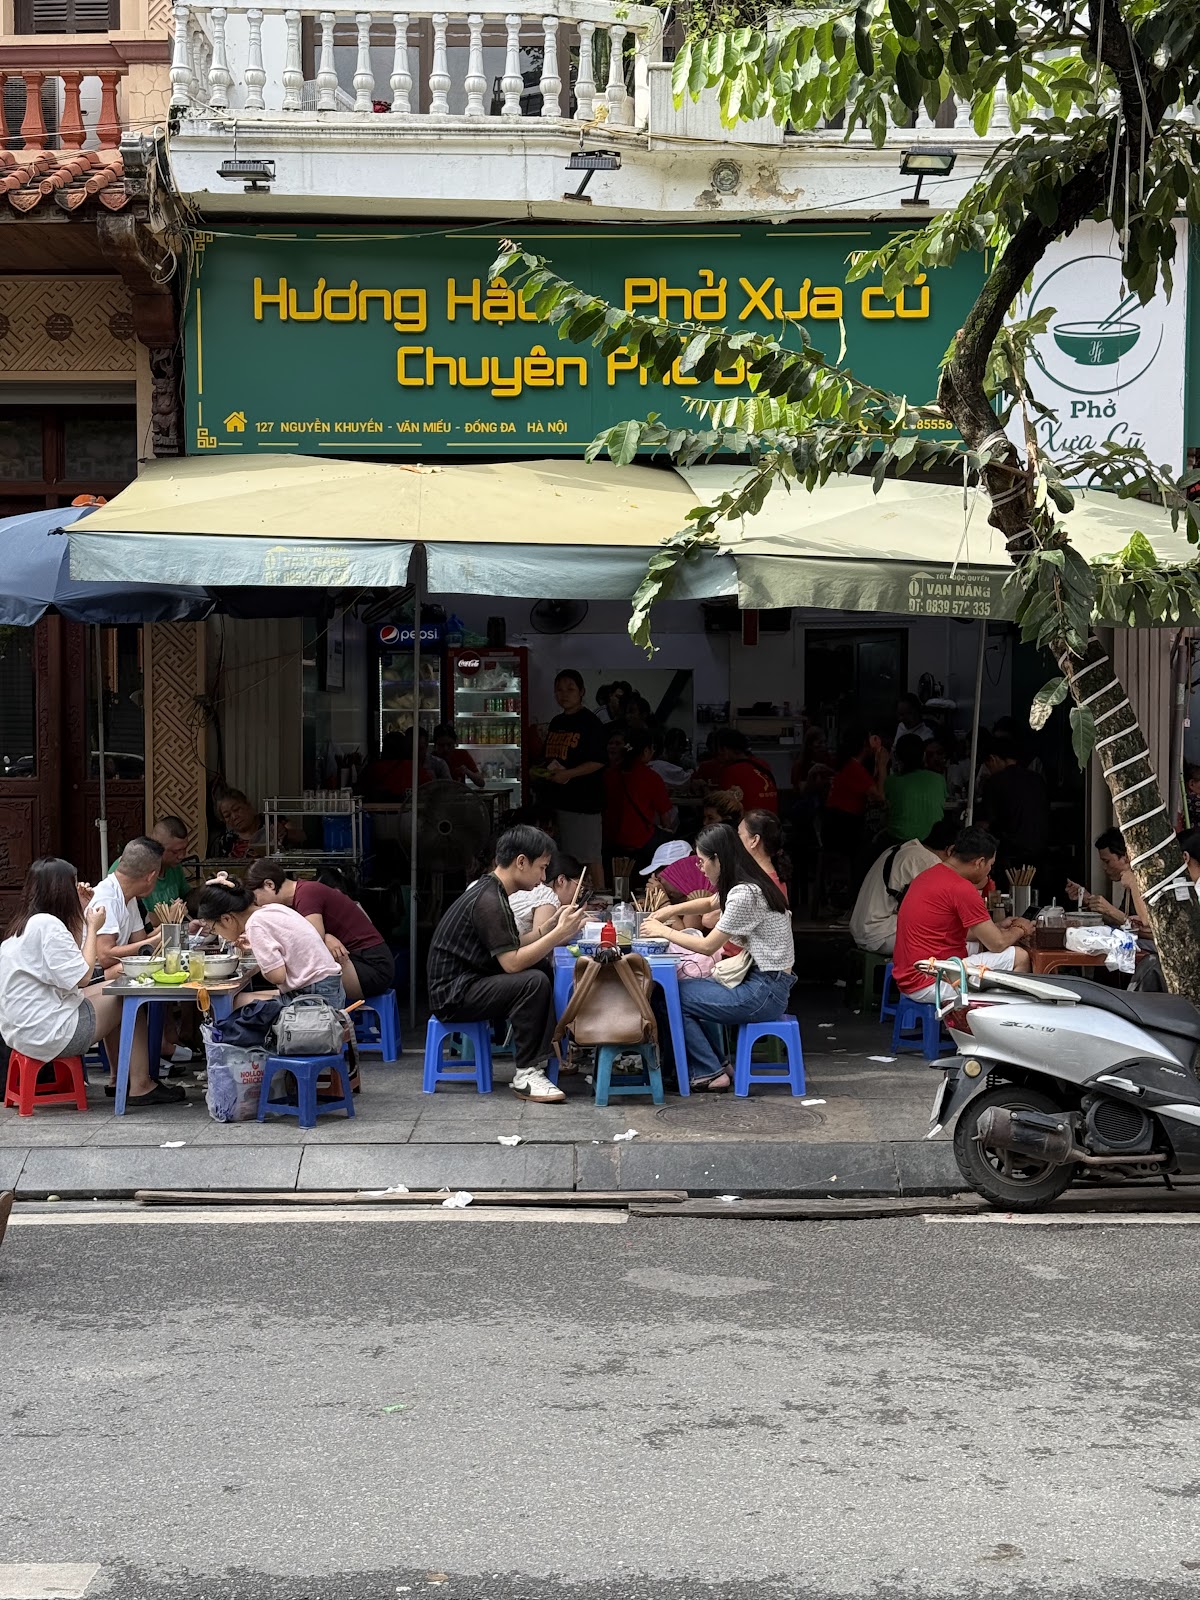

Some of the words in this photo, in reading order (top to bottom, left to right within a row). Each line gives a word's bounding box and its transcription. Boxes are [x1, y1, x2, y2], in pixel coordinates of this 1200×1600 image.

[253, 277, 427, 332] Hương
[624, 269, 728, 320] Phở
[738, 277, 843, 320] Xưa
[397, 344, 588, 397] Chuyên
[1070, 398, 1116, 418] Phở
[255, 422, 275, 433] 127
[281, 417, 331, 433] NGUYỄN
[334, 418, 383, 433] KHUYẾN
[396, 419, 420, 433] VĂN
[423, 418, 452, 433] MIẾU
[464, 418, 498, 433] ĐỐNG
[500, 422, 517, 433] ĐA
[527, 419, 545, 433] HÀ
[547, 419, 568, 434] NỘI
[1040, 421, 1097, 452] Xưa
[926, 599, 950, 614] 0839
[972, 602, 991, 616] 335
